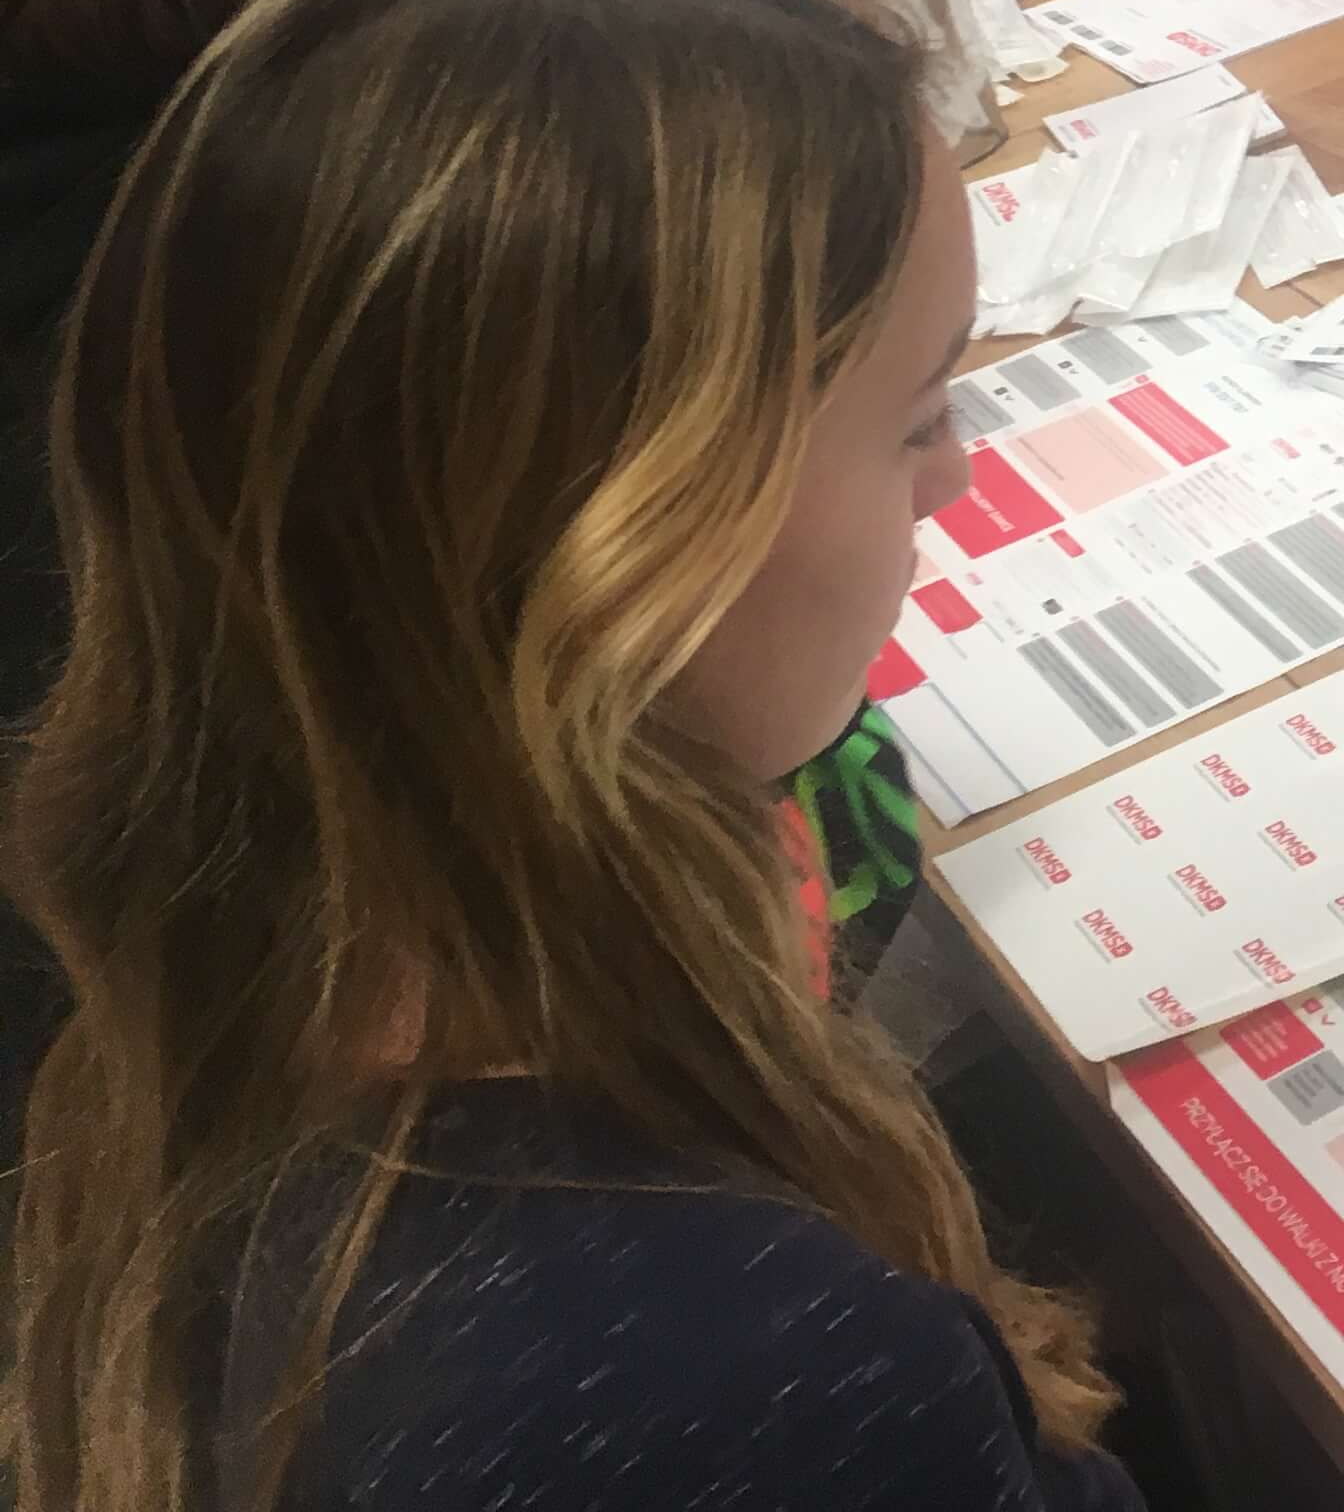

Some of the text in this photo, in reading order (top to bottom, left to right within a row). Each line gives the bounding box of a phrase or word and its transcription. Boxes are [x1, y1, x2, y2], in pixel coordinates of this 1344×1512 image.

[1179, 1096, 1250, 1170] PRZYŁĄCZ
[1238, 1165, 1268, 1193] SIĘ
[1256, 1186, 1287, 1213] DO
[1277, 1209, 1328, 1258] WALKI
[1315, 1253, 1338, 1271] Z
